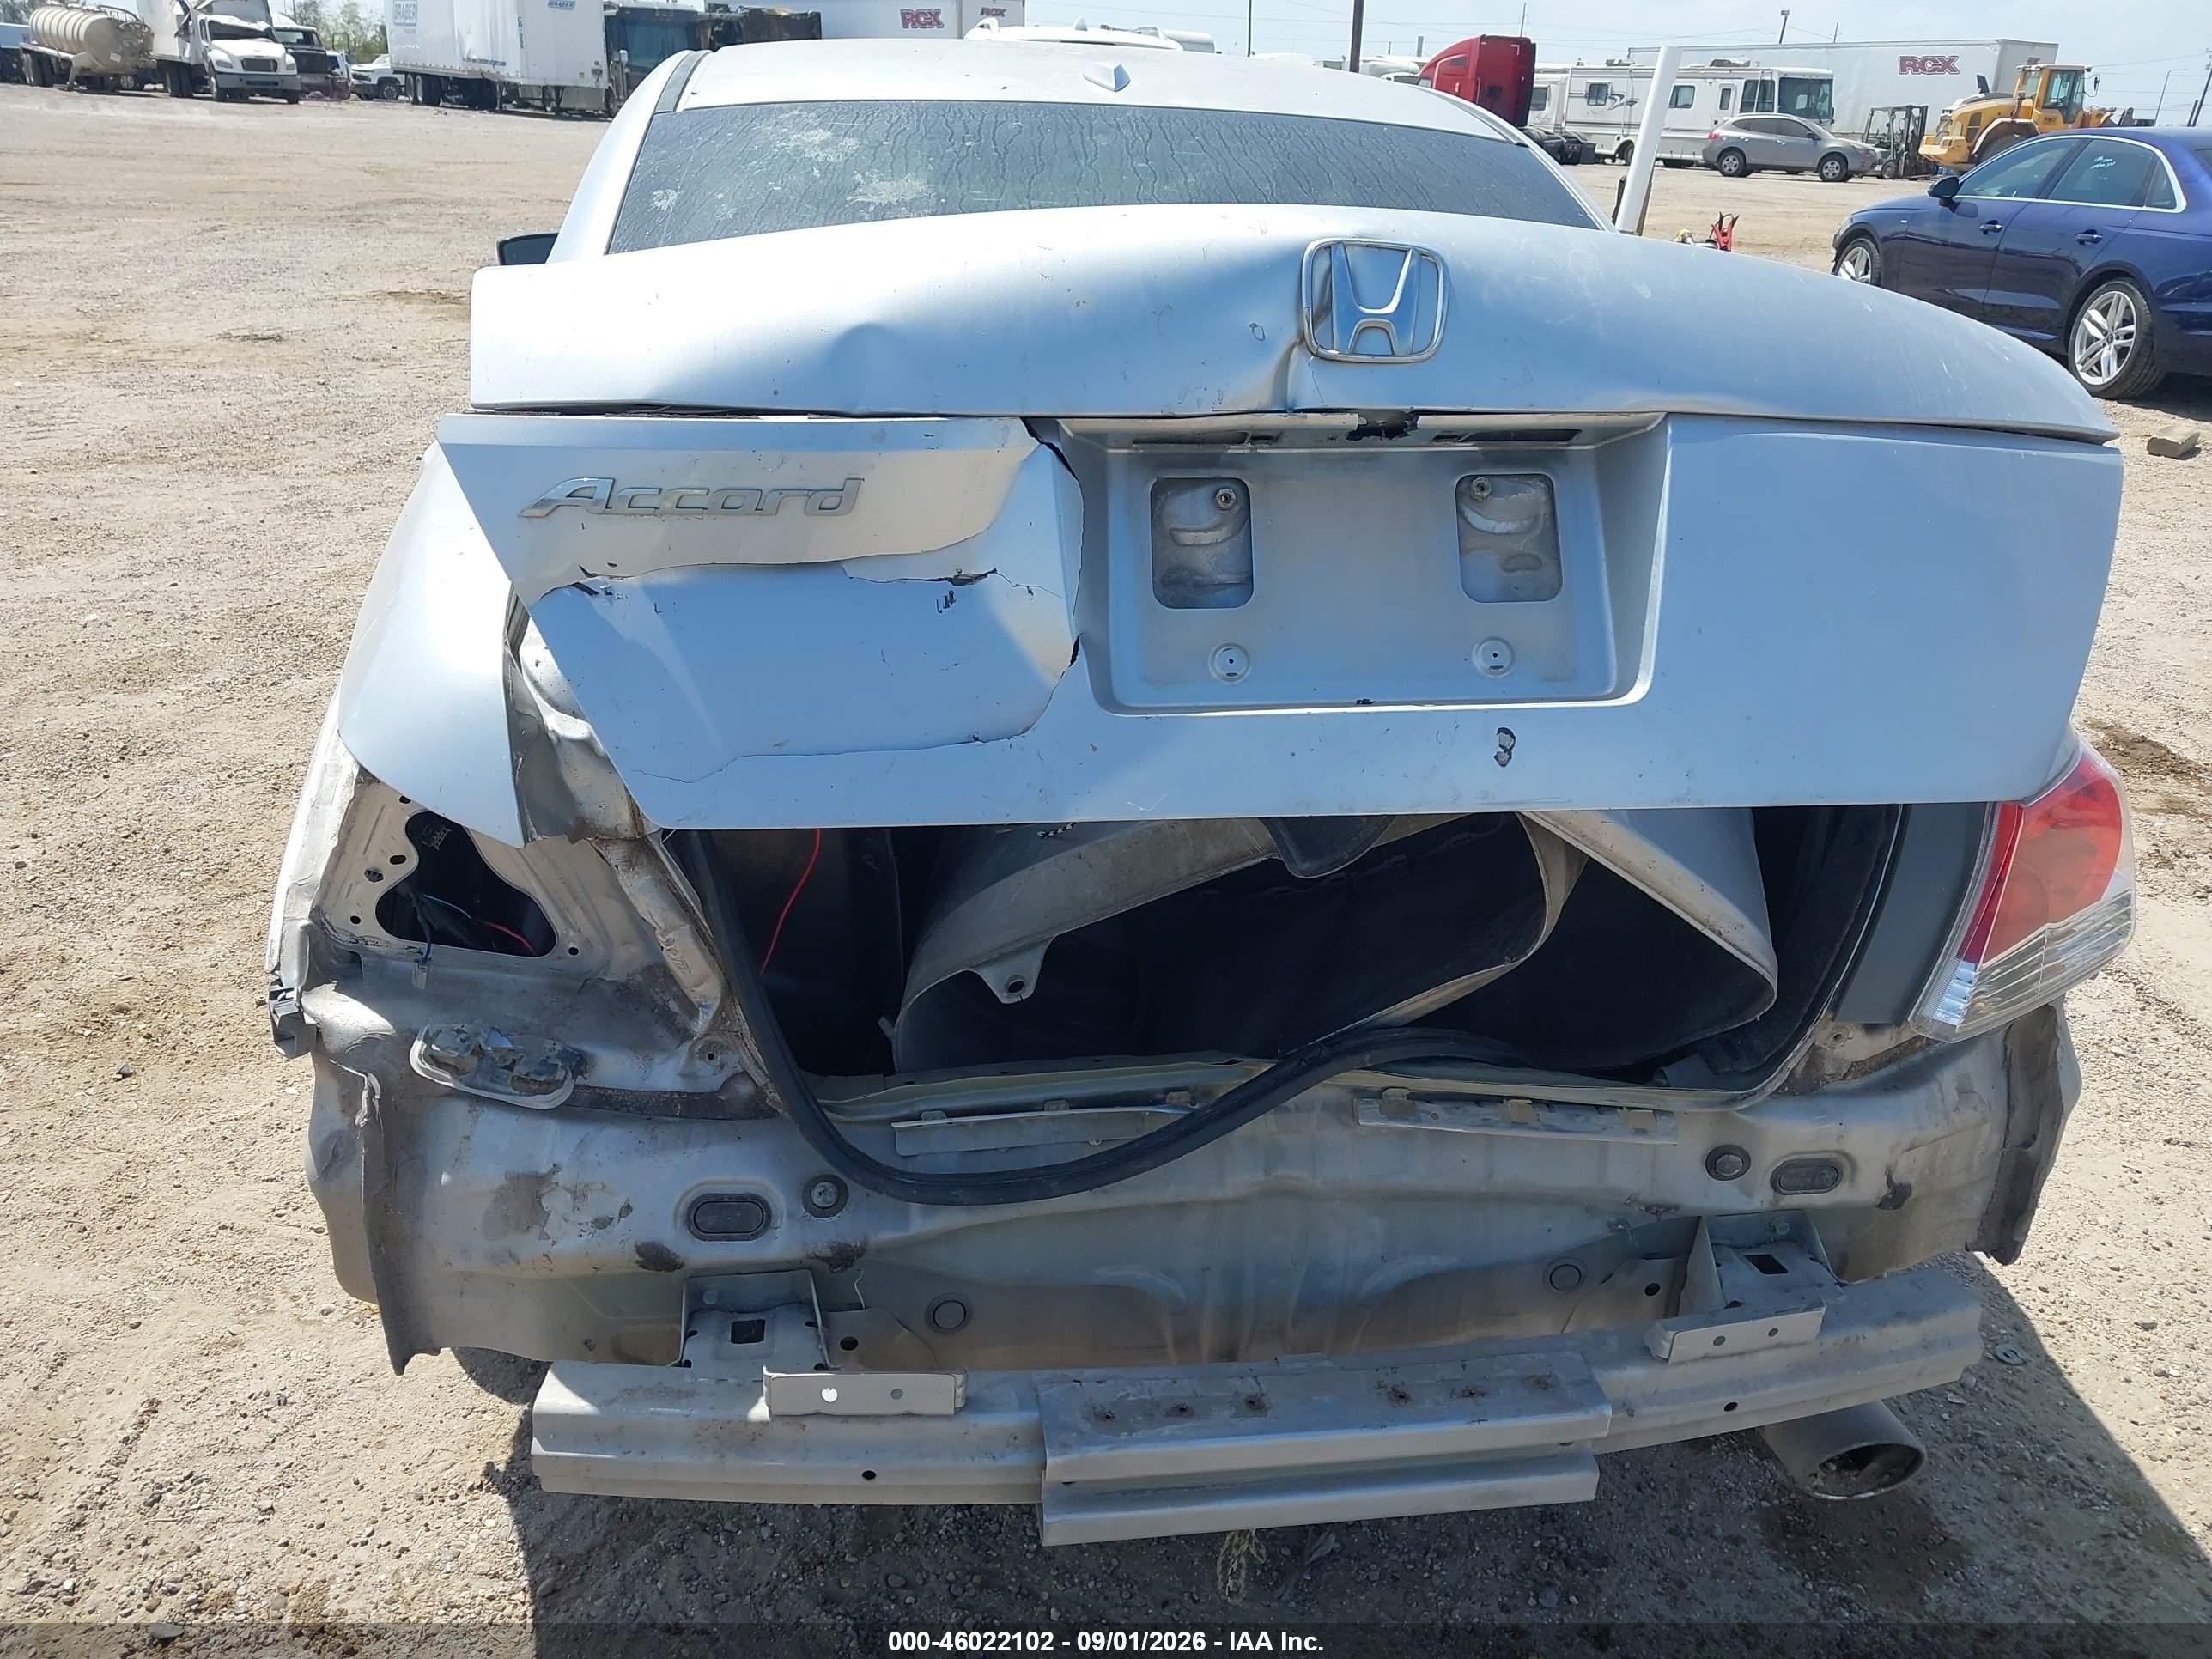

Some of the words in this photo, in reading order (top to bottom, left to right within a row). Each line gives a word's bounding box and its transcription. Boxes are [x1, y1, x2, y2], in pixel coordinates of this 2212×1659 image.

[900, 9, 945, 29] RCX
[1899, 56, 1960, 75] RCX
[520, 477, 863, 518] Accord
